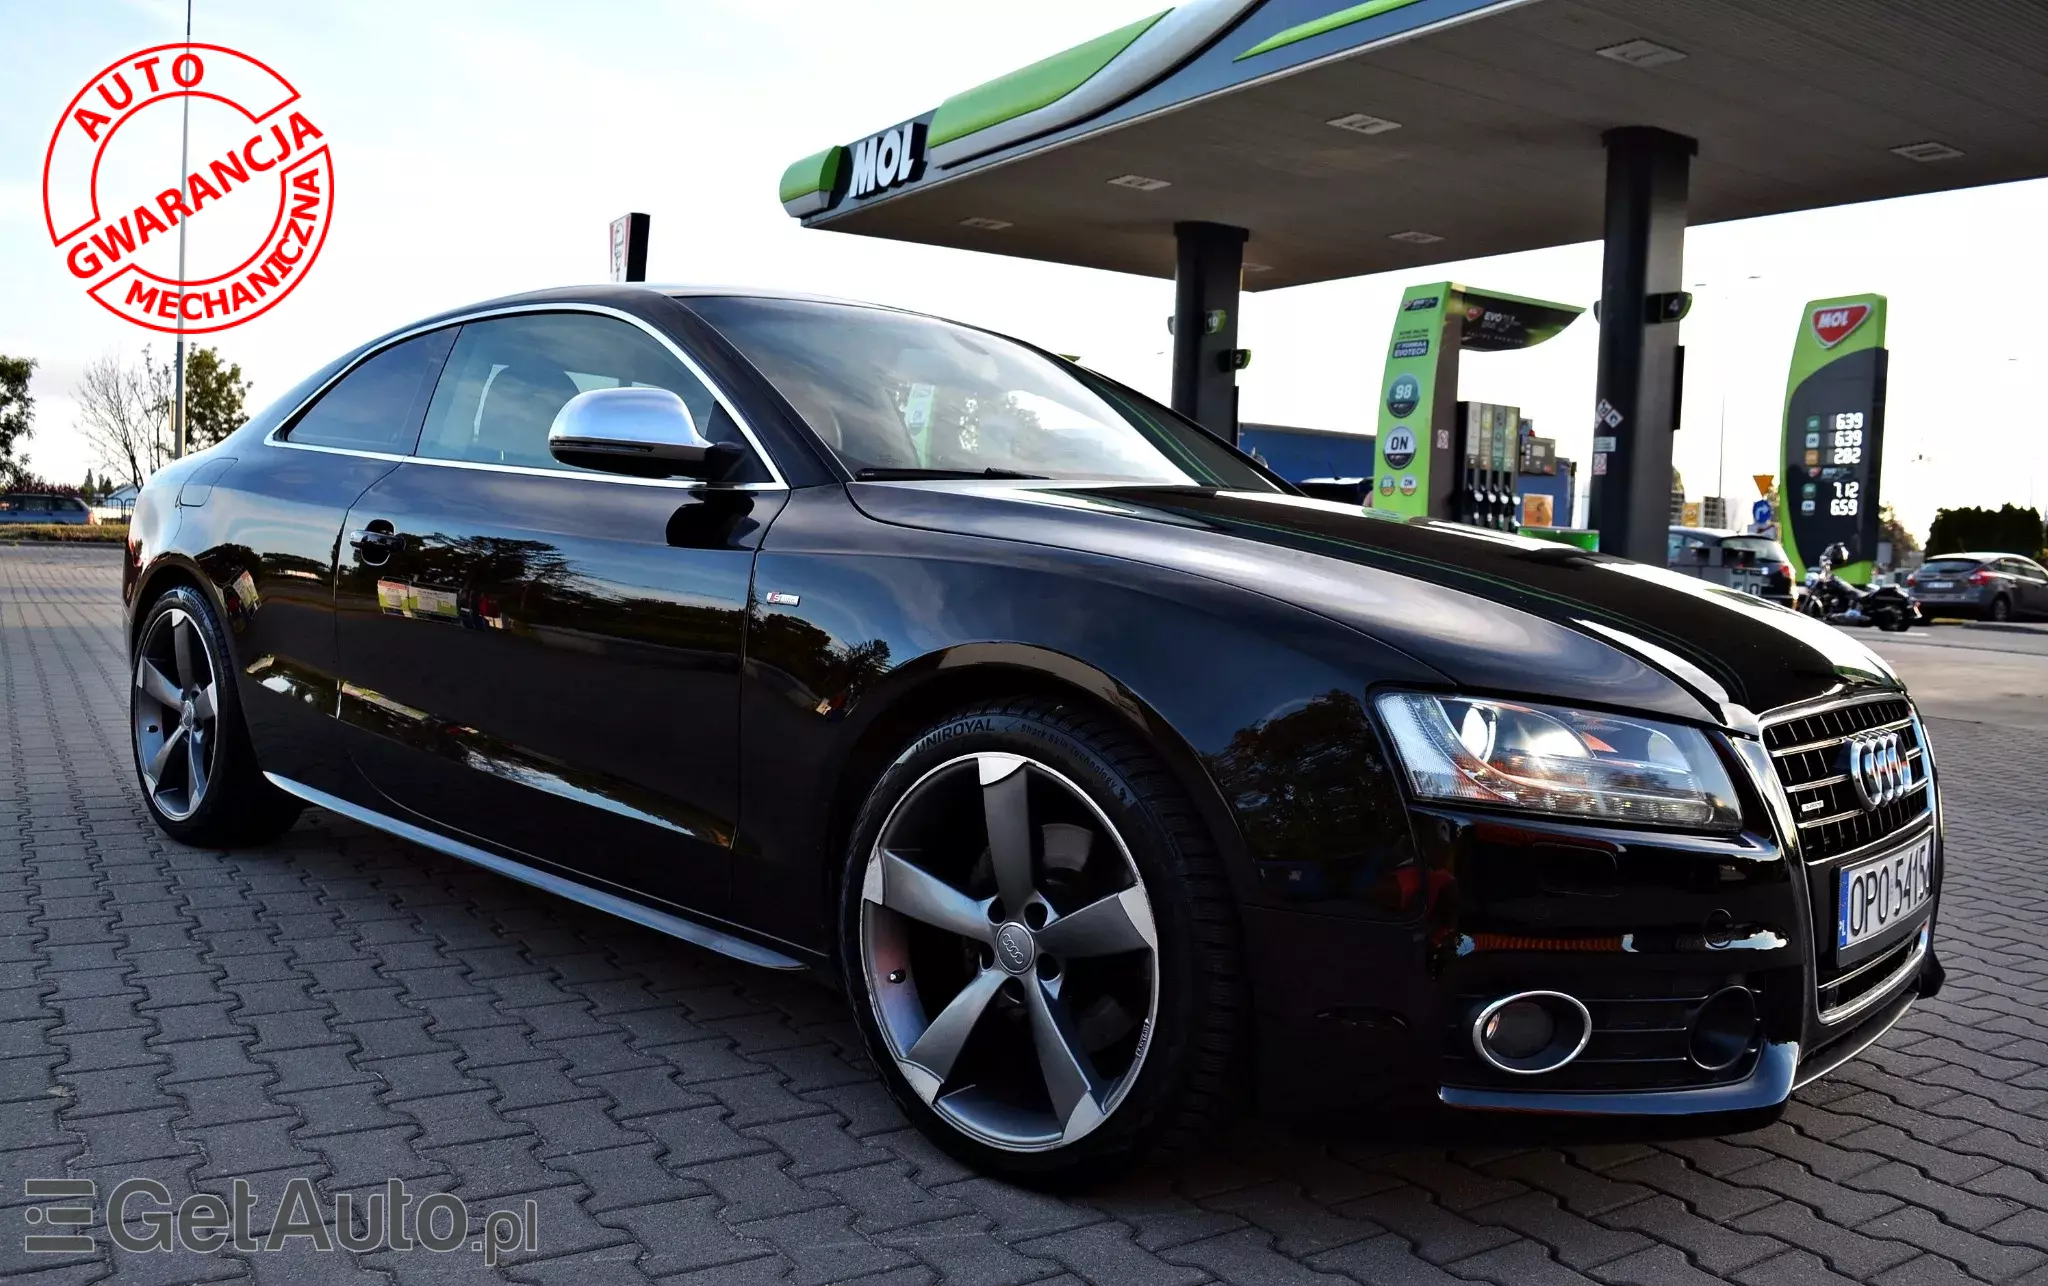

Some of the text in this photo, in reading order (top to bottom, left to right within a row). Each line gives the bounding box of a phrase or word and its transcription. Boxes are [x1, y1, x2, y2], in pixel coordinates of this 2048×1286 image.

[849, 121, 923, 200] MOL
[1818, 310, 1849, 329] MOL
[1395, 384, 1412, 400] 98
[1391, 436, 1409, 451] ON
[915, 718, 995, 755] UNIROYAL
